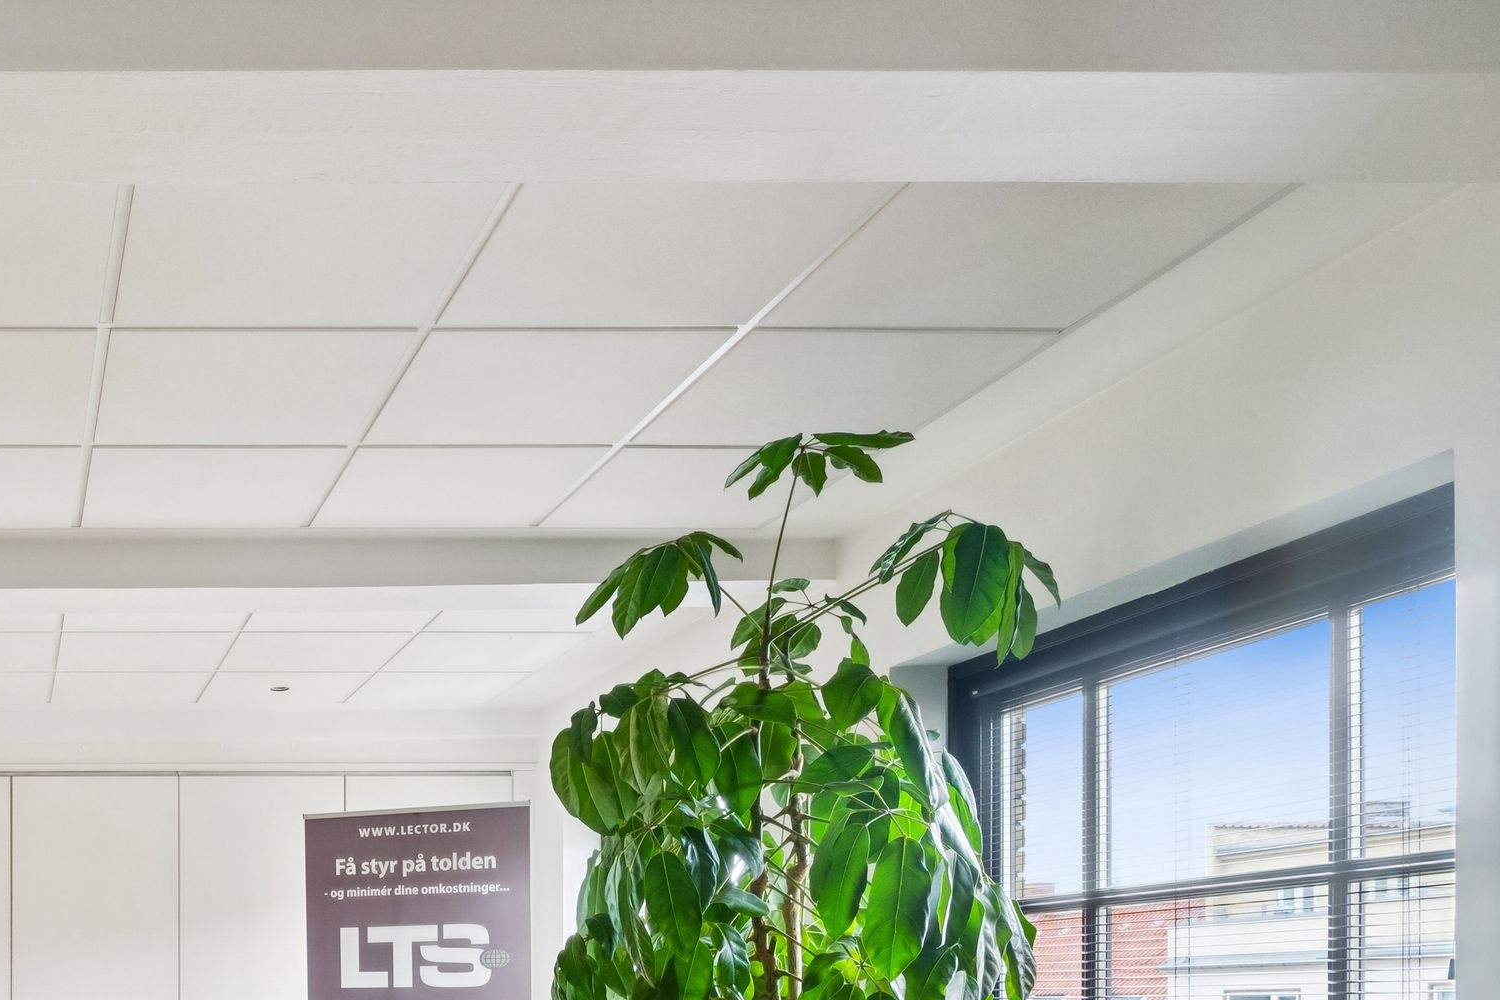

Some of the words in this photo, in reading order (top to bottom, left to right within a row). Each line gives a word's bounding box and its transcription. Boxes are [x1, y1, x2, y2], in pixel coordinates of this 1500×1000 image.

[359, 822, 470, 837] WWW.LECTOR.DK
[336, 857, 356, 875] Få
[361, 859, 397, 878] styr
[403, 854, 426, 877] på
[431, 852, 496, 871] tolden
[331, 890, 344, 900] og
[347, 886, 392, 897] minimér
[394, 885, 418, 895] dine
[421, 882, 510, 895] omkostninger...
[340, 924, 495, 989] LTS
